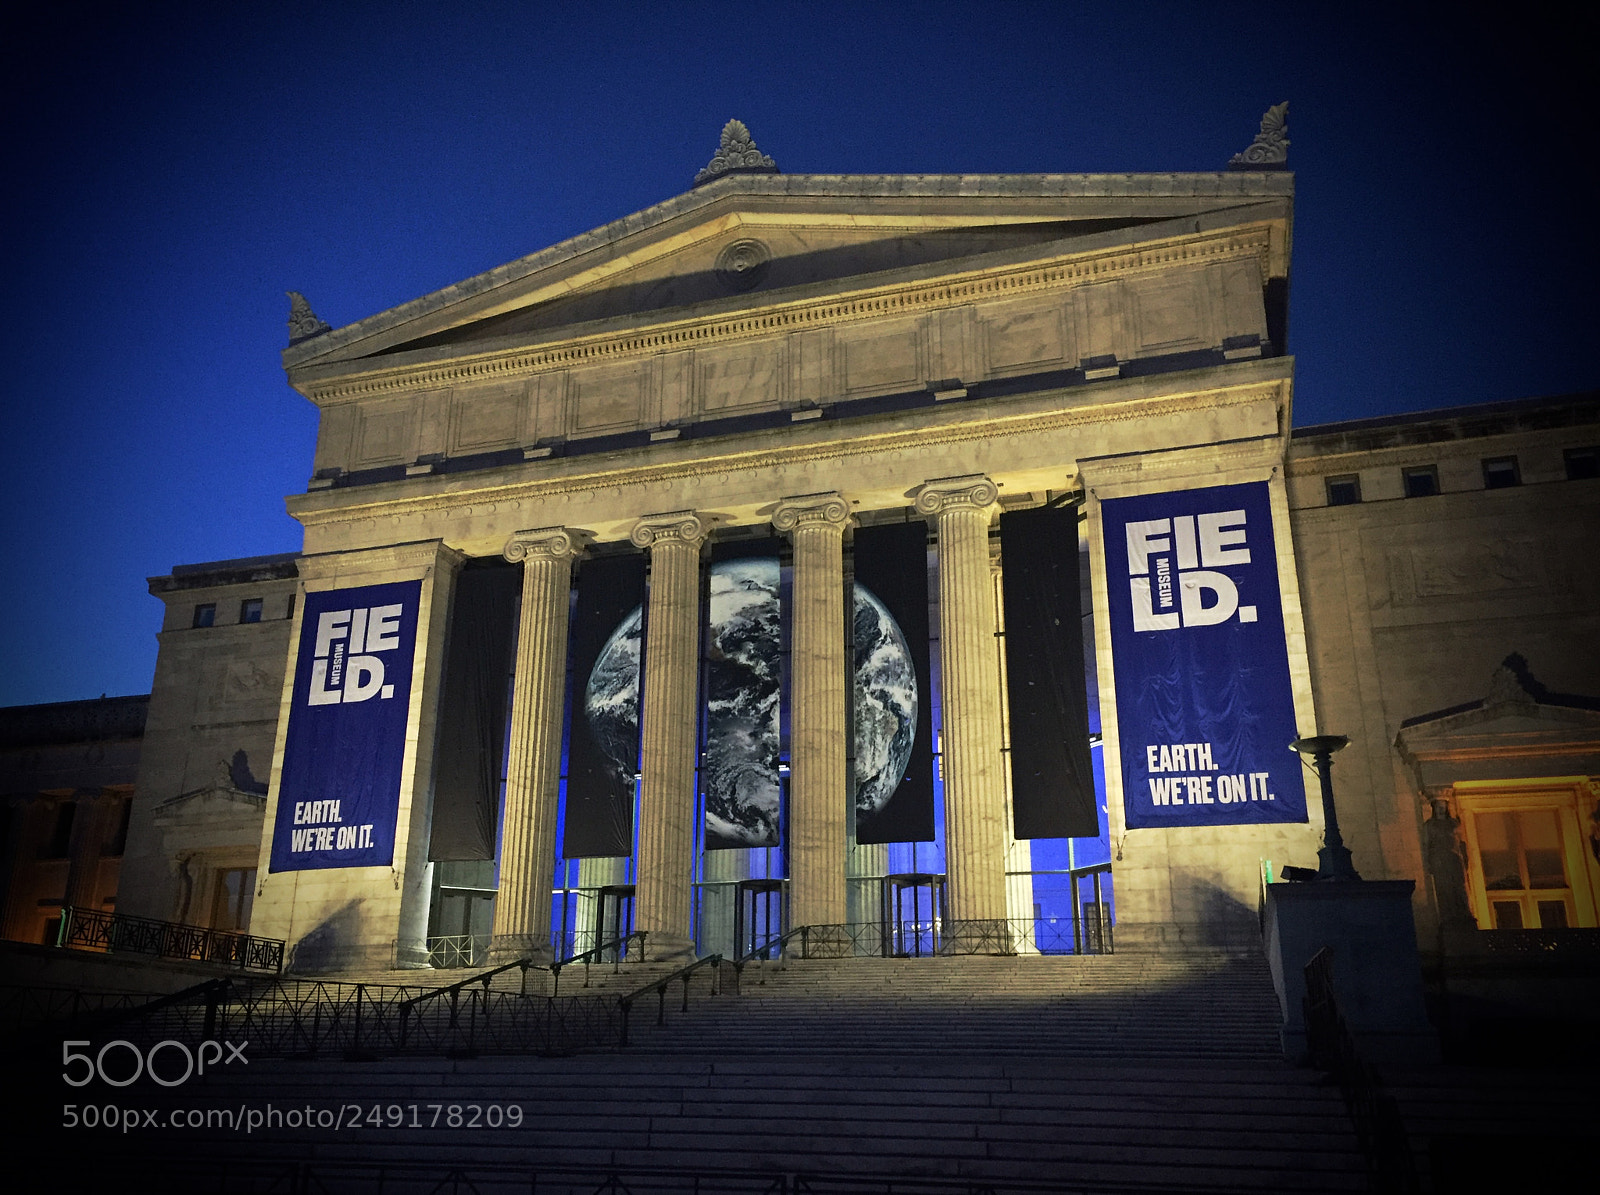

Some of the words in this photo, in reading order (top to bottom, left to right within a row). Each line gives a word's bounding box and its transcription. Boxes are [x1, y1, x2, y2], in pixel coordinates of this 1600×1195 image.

[1125, 509, 1251, 575] FIE
[1156, 557, 1173, 608] MUSEUM
[314, 603, 403, 657] FIE
[330, 643, 344, 686] MUSEUM
[1146, 742, 1219, 773] EARTH.
[1148, 775, 1215, 806] WE'RE
[1216, 773, 1248, 803] ON
[1248, 772, 1275, 801] IT.
[293, 799, 342, 825] EARTH.
[291, 826, 335, 853] WE'RE
[336, 825, 357, 851] ON
[358, 824, 374, 849] IT.
